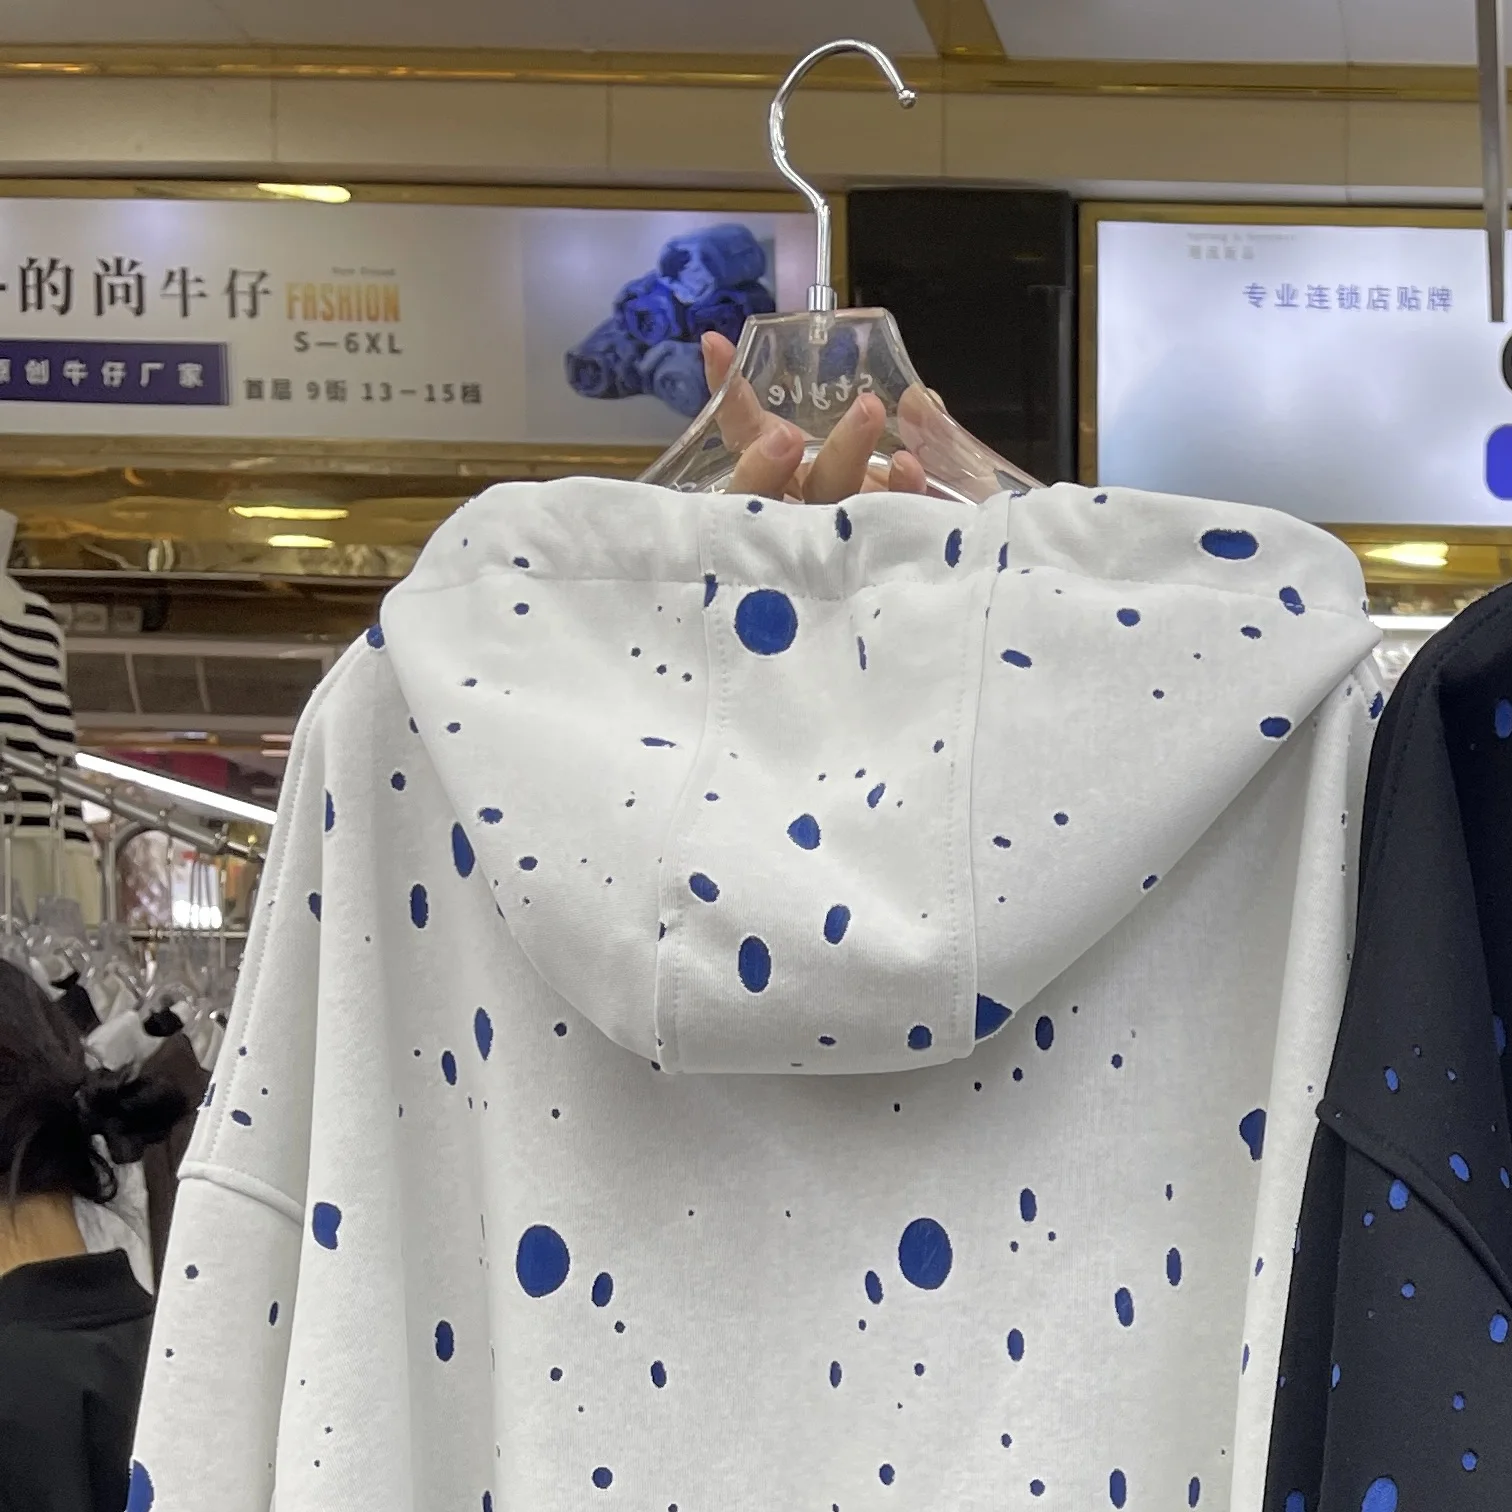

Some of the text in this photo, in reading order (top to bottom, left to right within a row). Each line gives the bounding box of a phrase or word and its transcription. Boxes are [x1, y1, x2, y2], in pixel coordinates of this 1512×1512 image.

[285, 282, 402, 322] FASHION
[1243, 283, 1453, 311] 专业连锁店贴牌
